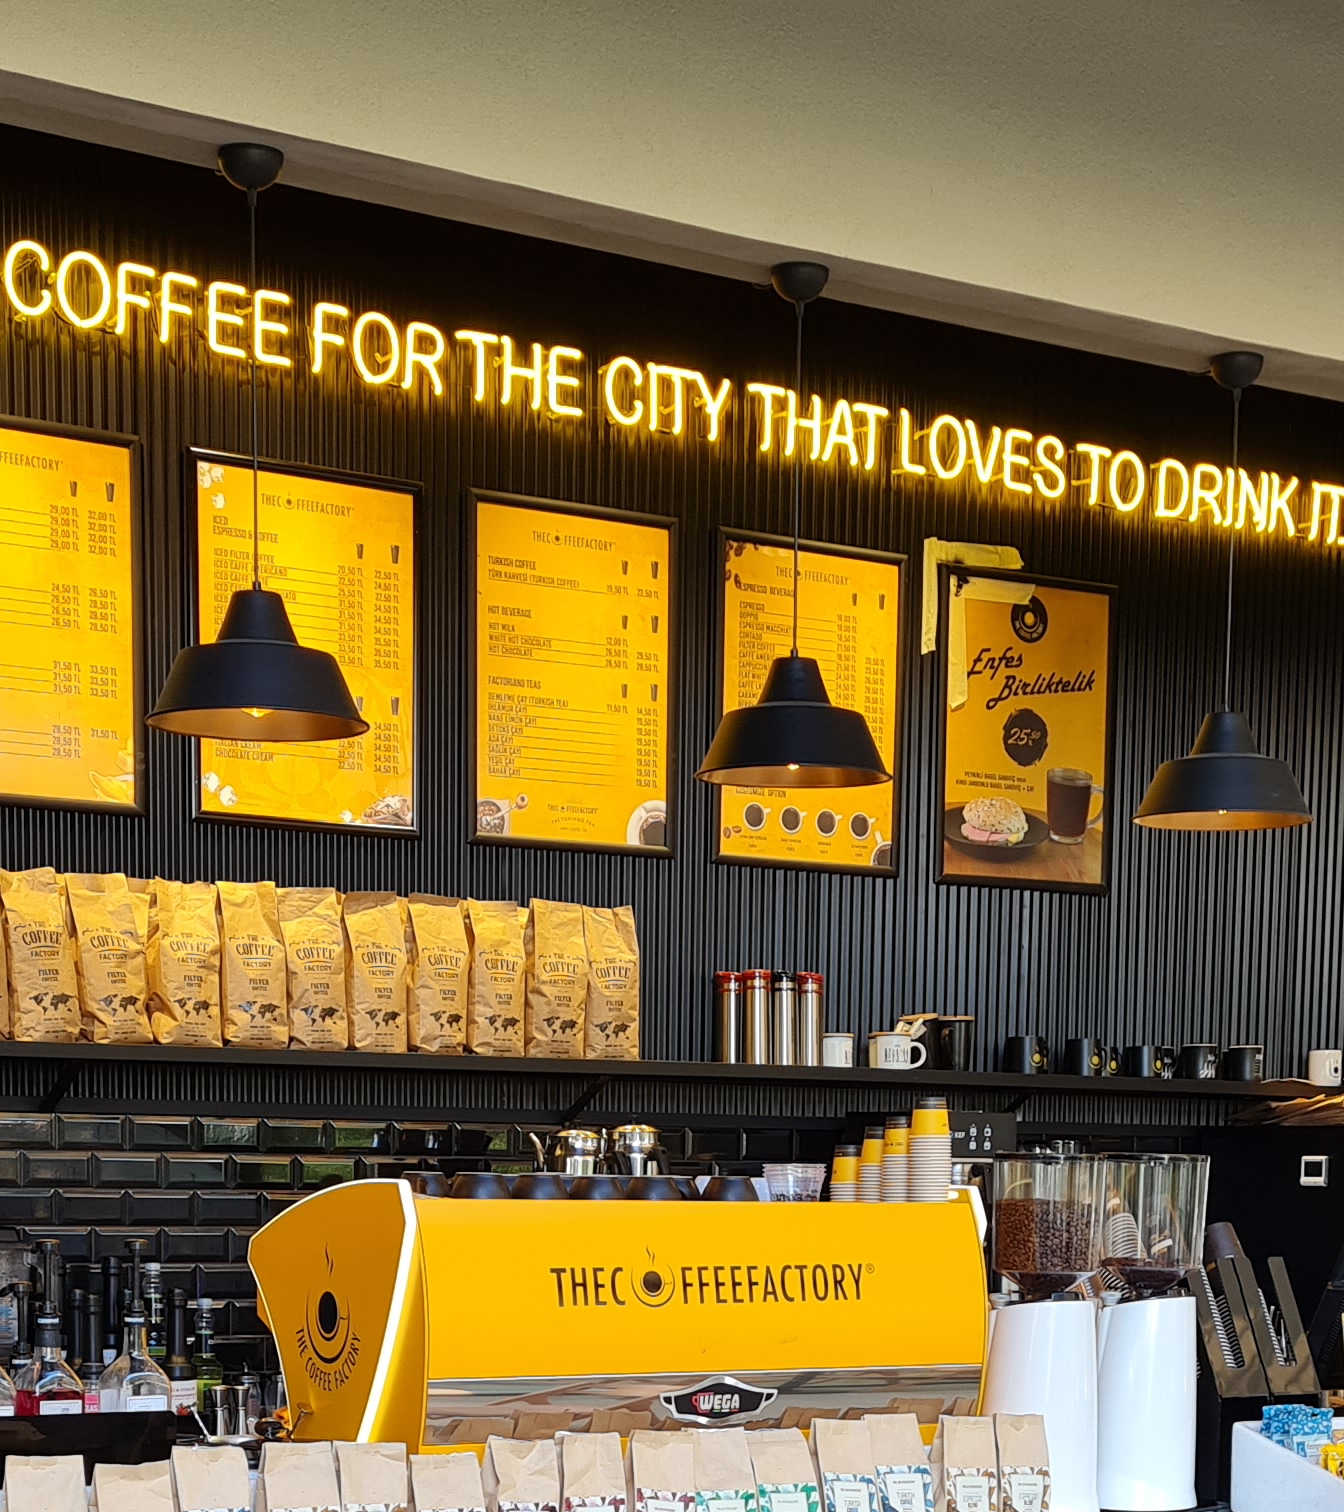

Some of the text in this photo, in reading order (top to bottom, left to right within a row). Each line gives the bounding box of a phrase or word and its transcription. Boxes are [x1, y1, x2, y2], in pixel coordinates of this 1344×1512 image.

[5, 239, 293, 368] COFFEE
[312, 301, 445, 397] FOR
[455, 329, 584, 418] THE
[603, 355, 731, 443] CITY
[748, 381, 889, 472] THAT
[898, 408, 1065, 500] LOVES
[1076, 441, 1145, 514] TO
[1155, 457, 1299, 538] DRINK
[71, 506, 80, 518] TL
[108, 512, 116, 523] TL
[213, 515, 228, 525] ICED
[213, 525, 247, 539] ESPRESSO
[214, 547, 250, 560] ICED FILTER
[515, 559, 536, 570] COFFEE
[488, 604, 532, 619] HOT BEVERAGE
[501, 624, 516, 632] MILK
[508, 635, 519, 645] HOT
[520, 637, 552, 648] CHOCOLATE
[488, 644, 533, 657] HOT CHOCOLATE
[73, 662, 81, 672] TL
[110, 666, 118, 676] TL
[967, 646, 1023, 680] Enfes
[526, 679, 541, 689] TEAS
[986, 669, 1096, 710] Birliktelik
[215, 748, 274, 762] CHOCOLATE CREAM
[21, 929, 63, 946] COFFEE
[90, 934, 130, 949] COFFEE
[236, 943, 276, 958] COFFEE
[296, 946, 335, 961] COFFEE
[361, 951, 397, 966] COFFEE
[542, 961, 578, 976] COFFEE
[296, 1326, 361, 1392] THE COFFEE FACTORY
[698, 1393, 740, 1411] WEGA
